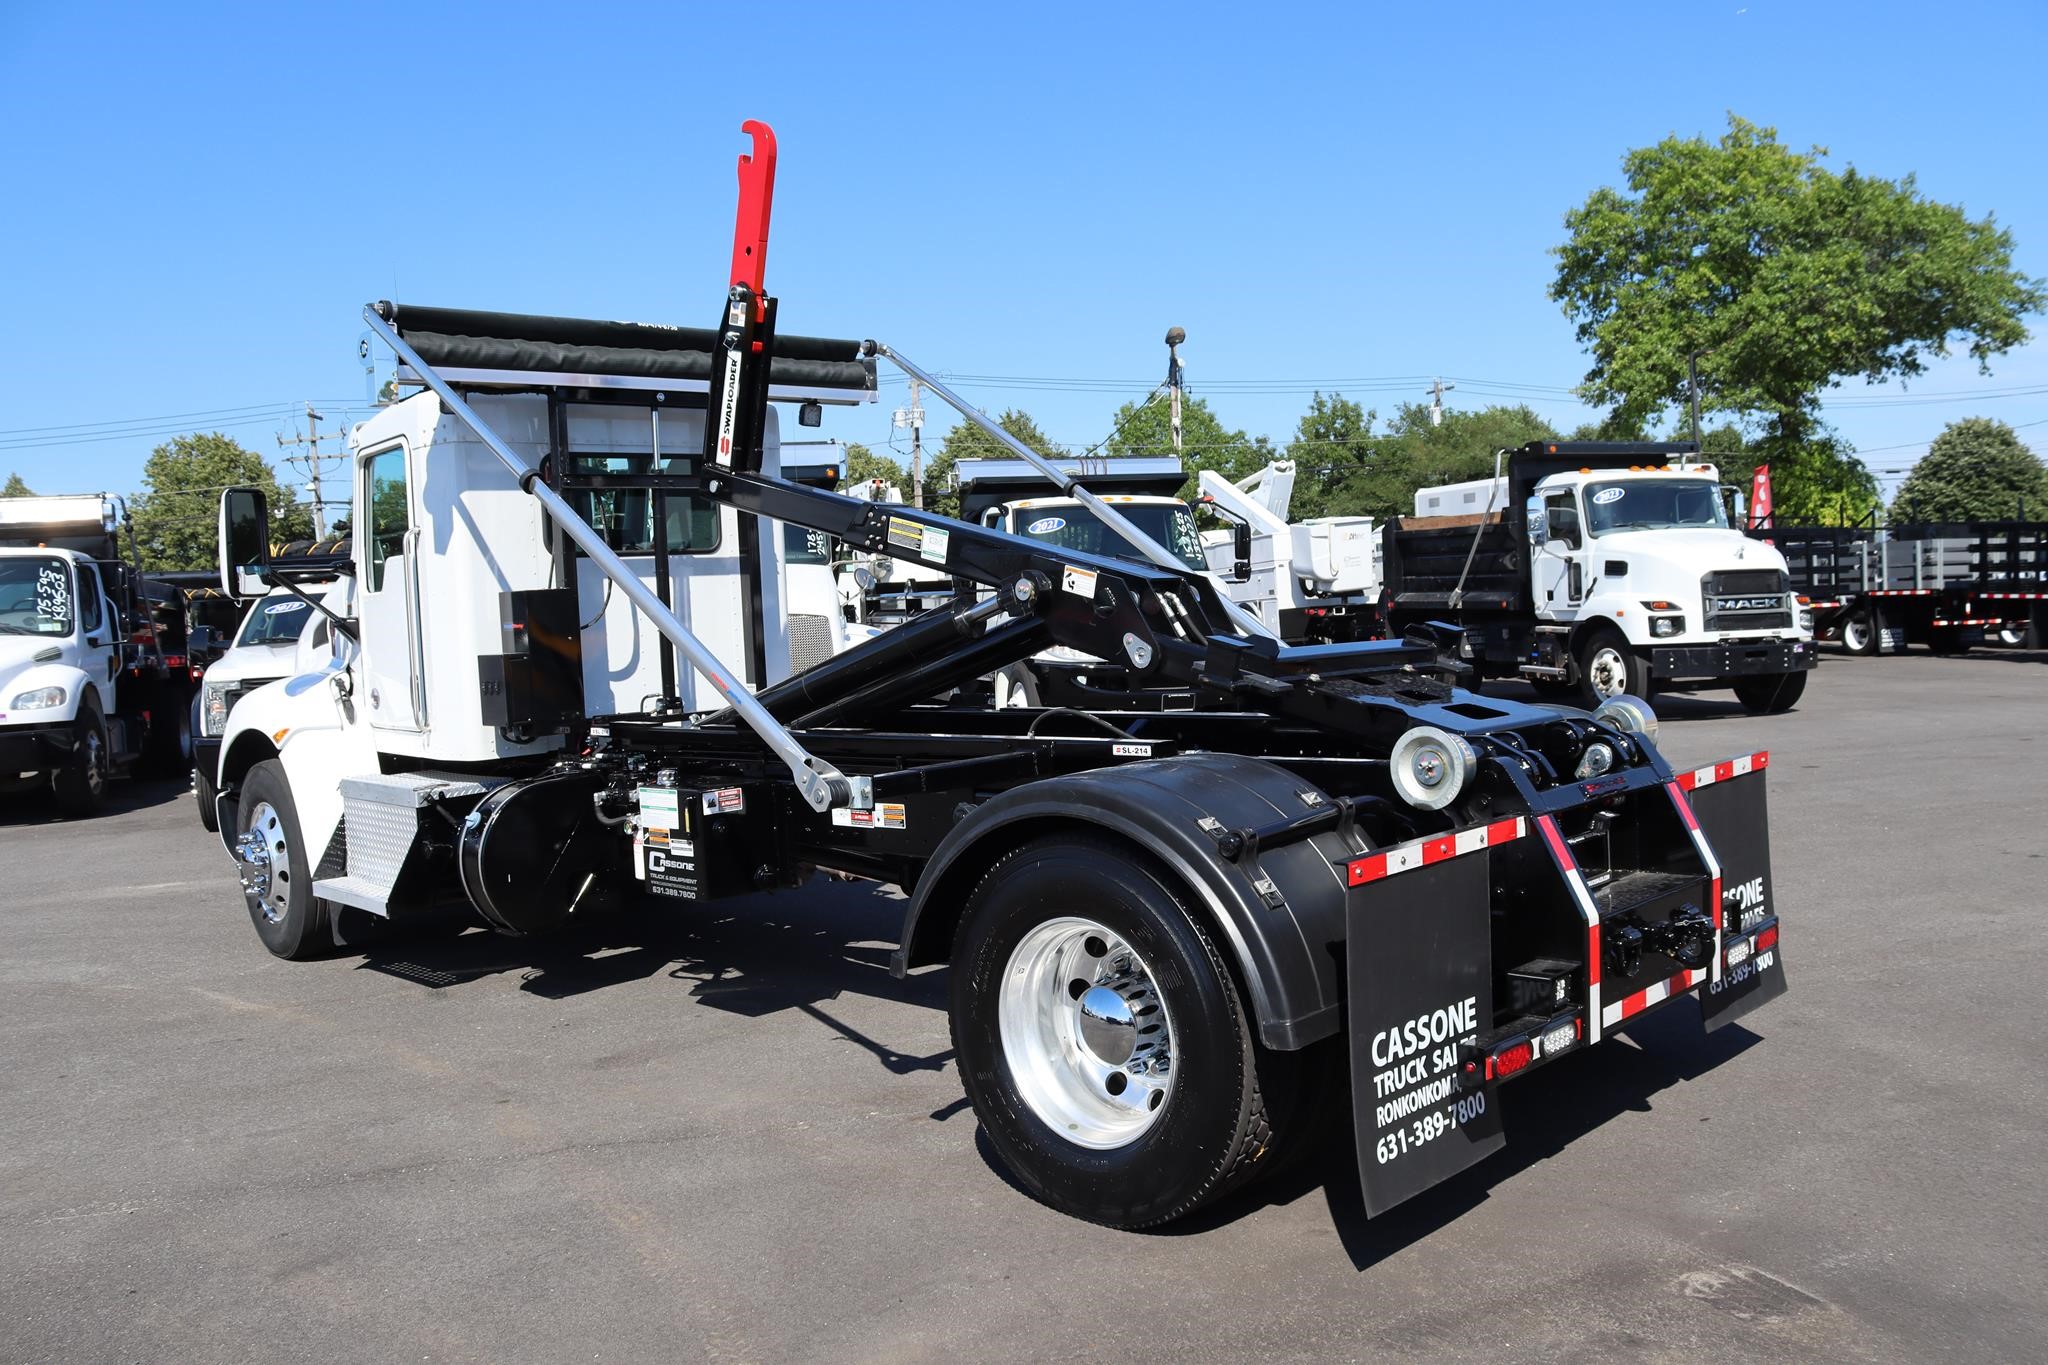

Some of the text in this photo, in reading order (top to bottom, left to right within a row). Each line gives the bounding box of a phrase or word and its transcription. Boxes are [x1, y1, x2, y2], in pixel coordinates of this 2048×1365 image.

[723, 359, 738, 435] SWAPLOADER
[1035, 520, 1058, 532] 2021
[1717, 598, 1779, 609] MACK
[1122, 746, 1148, 754] SL-214
[649, 851, 695, 872] CASSONE
[650, 872, 665, 880] TRUCK
[1371, 996, 1478, 1067] CASSONE
[1373, 1054, 1428, 1099] TRUCK
[1376, 1090, 1486, 1165] 631-389-7800
